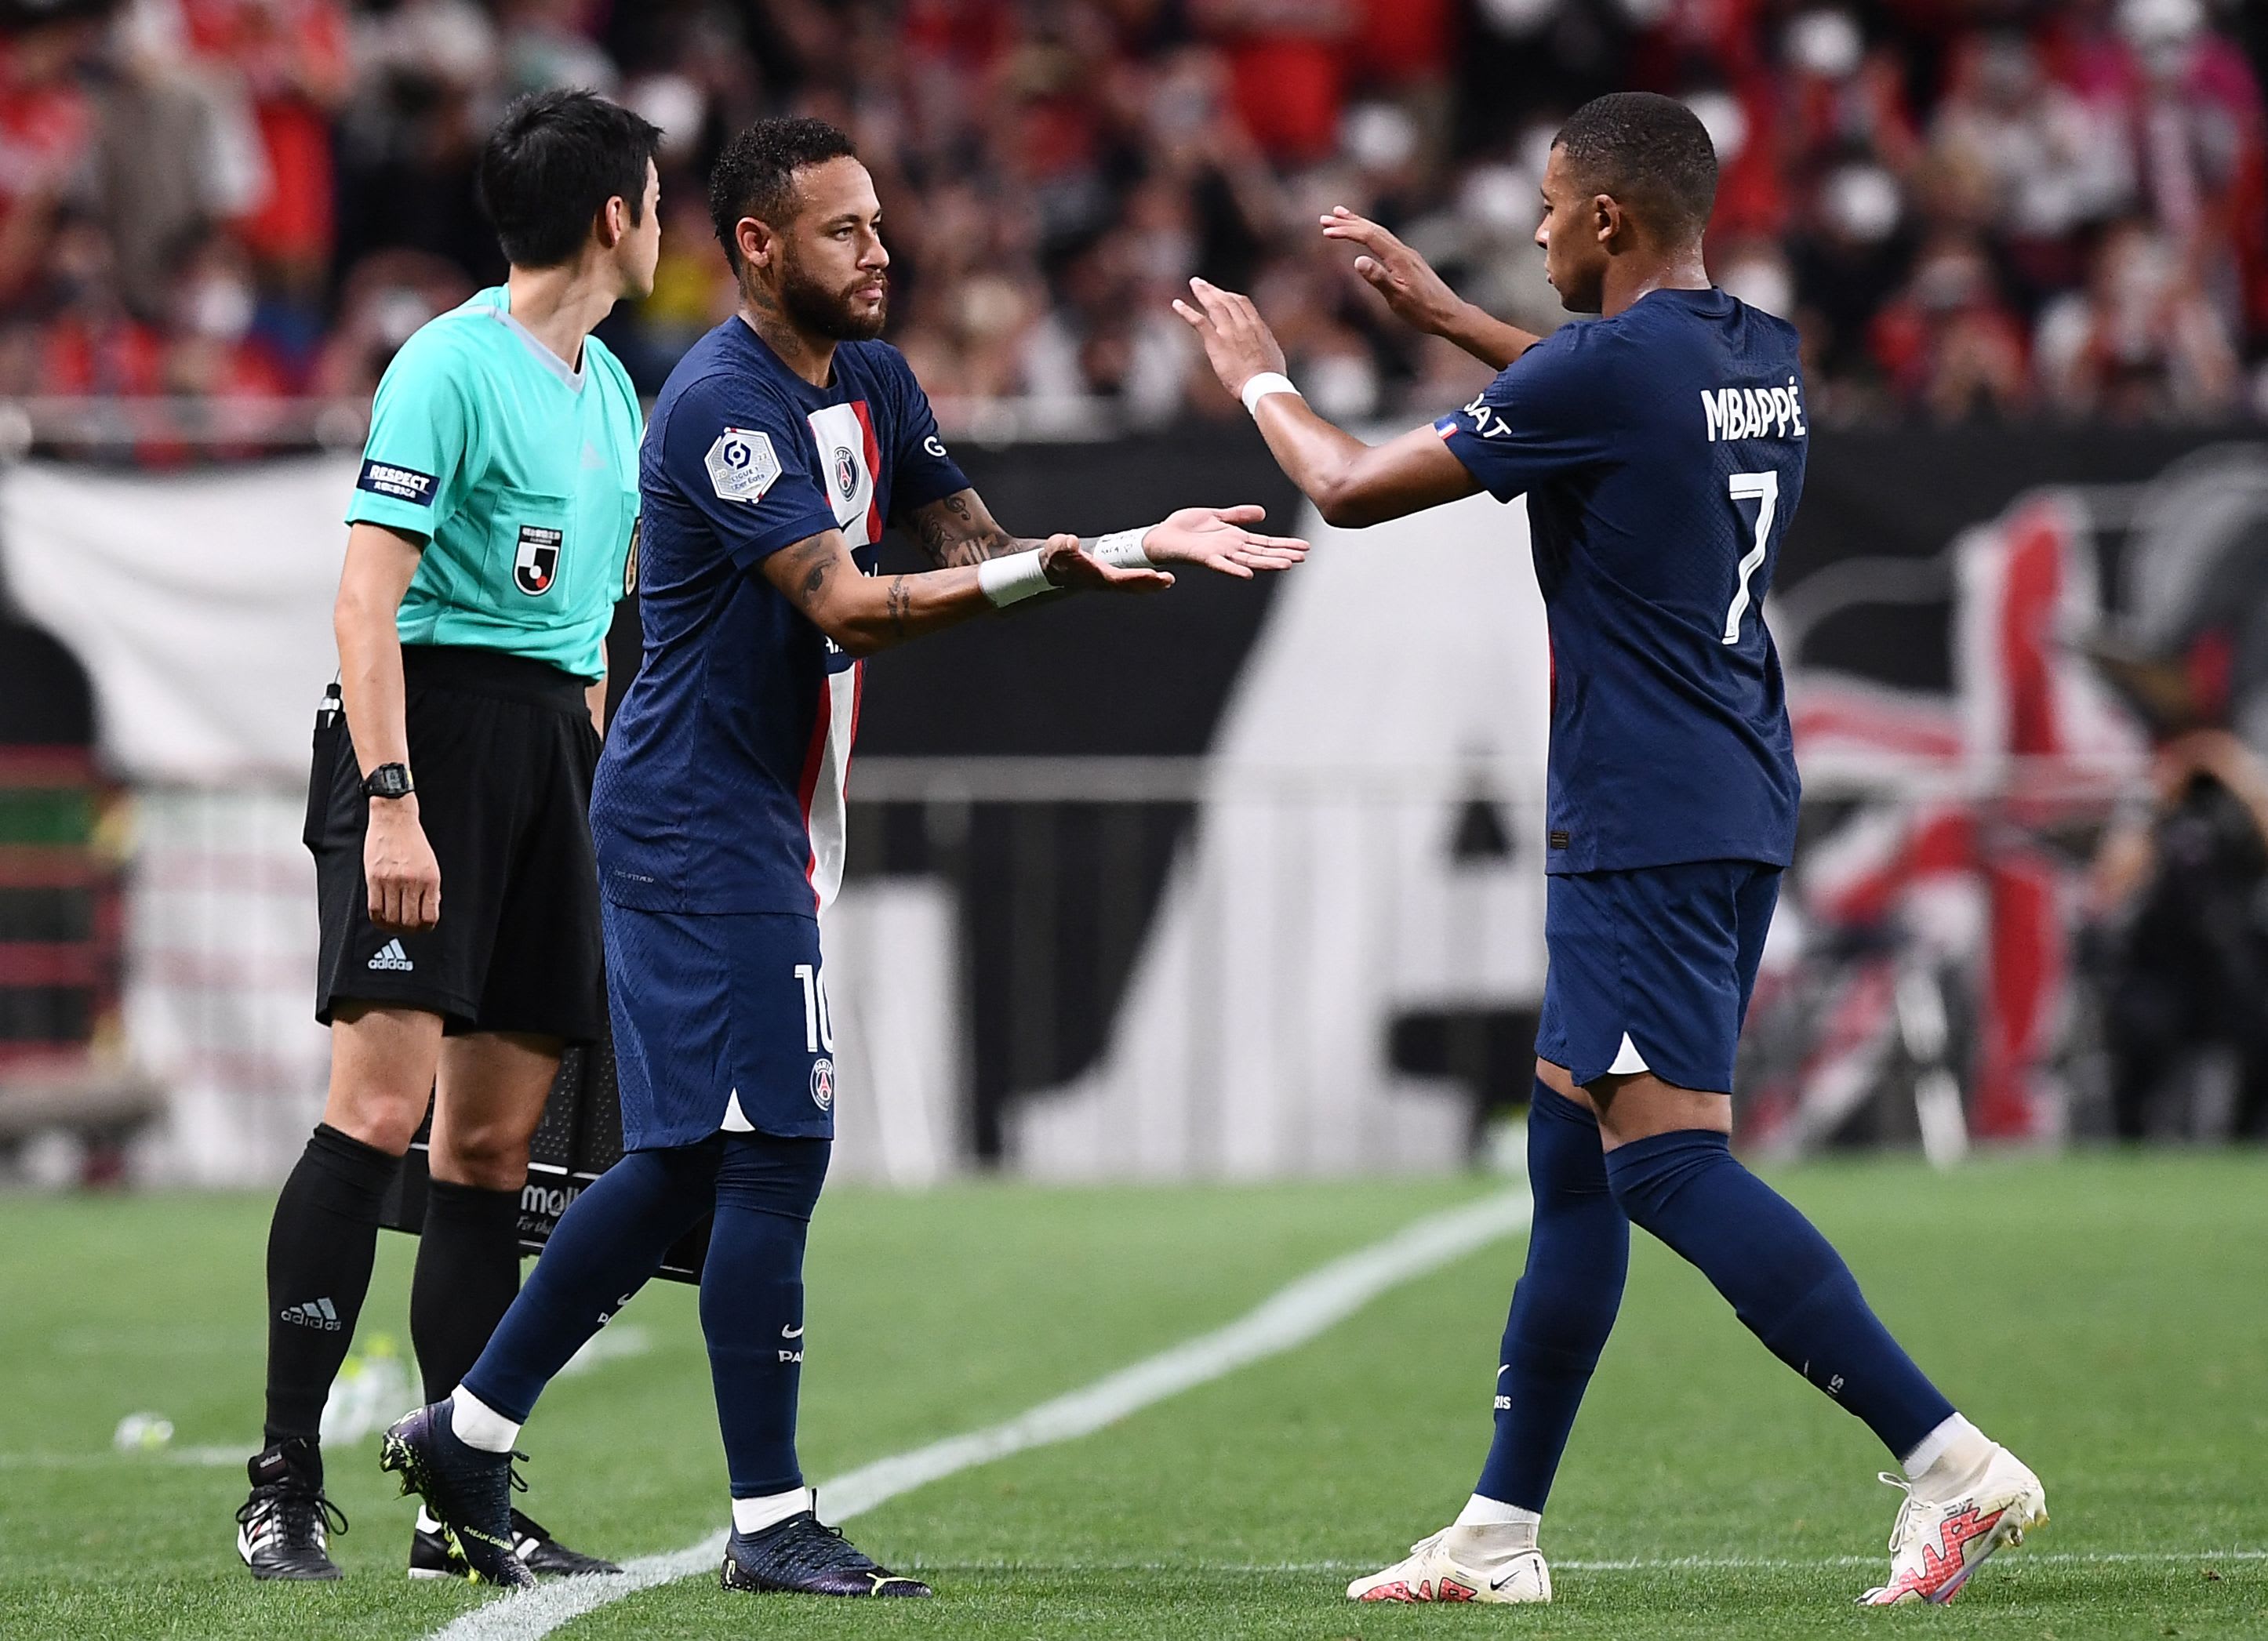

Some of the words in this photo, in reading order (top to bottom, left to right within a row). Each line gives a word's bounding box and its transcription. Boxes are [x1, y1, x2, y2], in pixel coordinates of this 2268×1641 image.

[1700, 376, 1806, 442] MBAPPÉ
[369, 464, 431, 492] RESPECT
[731, 468, 754, 482] LIGUE
[747, 472, 765, 485] Eats
[1722, 470, 1778, 644] 7
[367, 957, 414, 971] adidas
[280, 1309, 342, 1331] adidas
[777, 1349, 804, 1363] PA
[463, 1525, 489, 1541] DREAM
